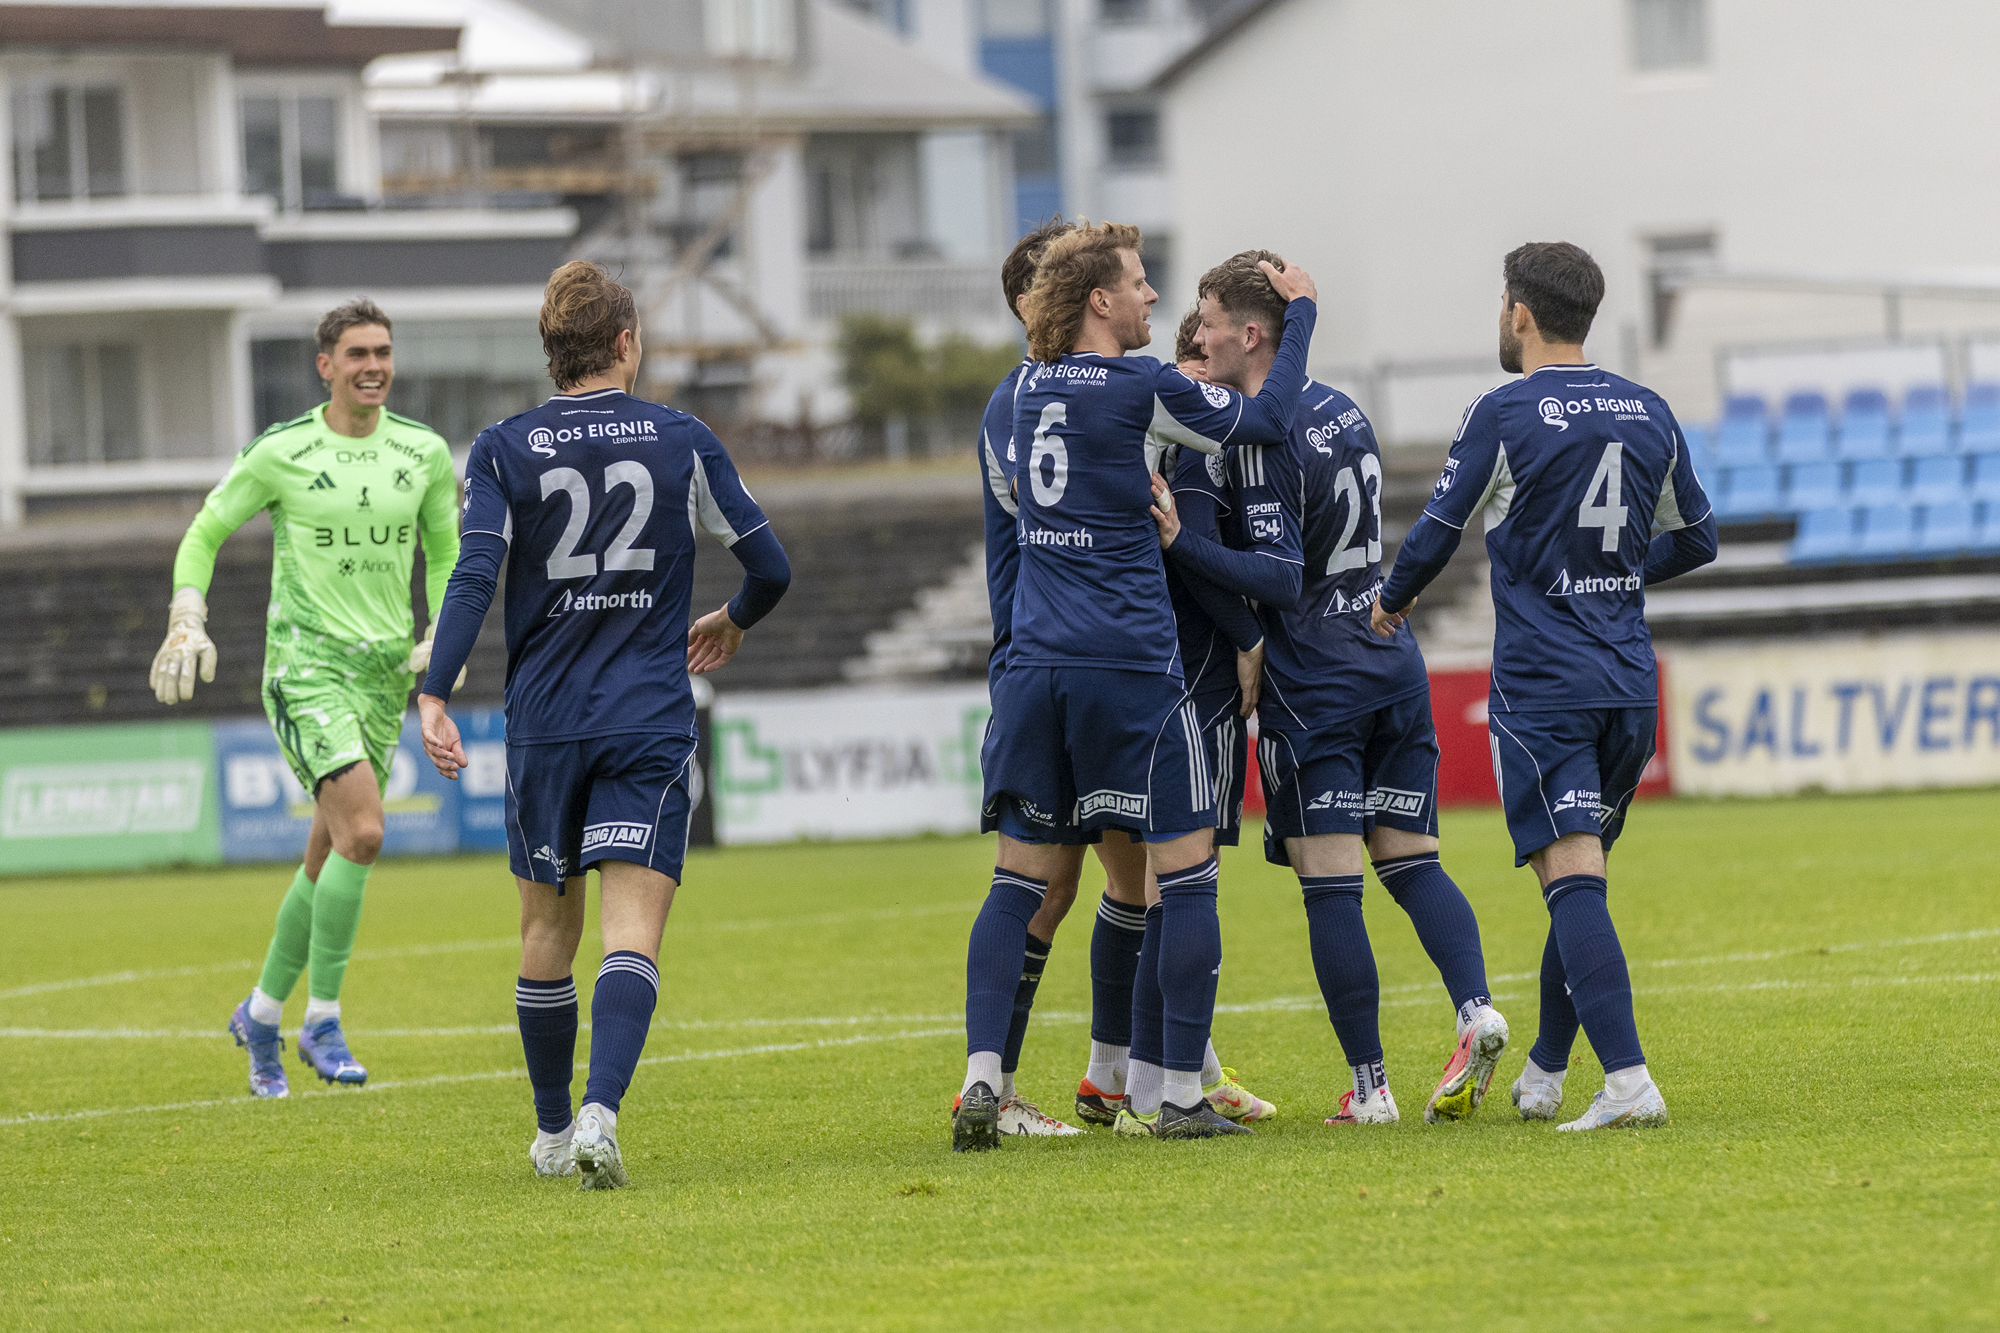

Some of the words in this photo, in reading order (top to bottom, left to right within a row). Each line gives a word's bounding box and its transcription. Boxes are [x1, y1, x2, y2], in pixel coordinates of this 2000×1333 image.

[1054, 364, 1108, 380] EIGNIR
[1566, 398, 1592, 414] OS
[1594, 397, 1648, 414] EIGNIR
[556, 426, 583, 443] OS
[588, 420, 658, 438] EIGNIR
[1321, 420, 1341, 440] OS
[1336, 407, 1364, 429] EIGNIR
[638, 435, 659, 443] HEIM
[1028, 401, 1069, 507] 6
[1246, 502, 1282, 515] SPORT
[1577, 442, 1629, 553] 4
[539, 460, 656, 580] 22
[1326, 453, 1383, 576] 23
[315, 524, 411, 548] BLUE
[1029, 527, 1093, 547] atnorth
[1252, 518, 1281, 538] 24
[359, 558, 396, 574] Arion
[1574, 571, 1641, 594] atnorth
[574, 588, 653, 611] atnorth
